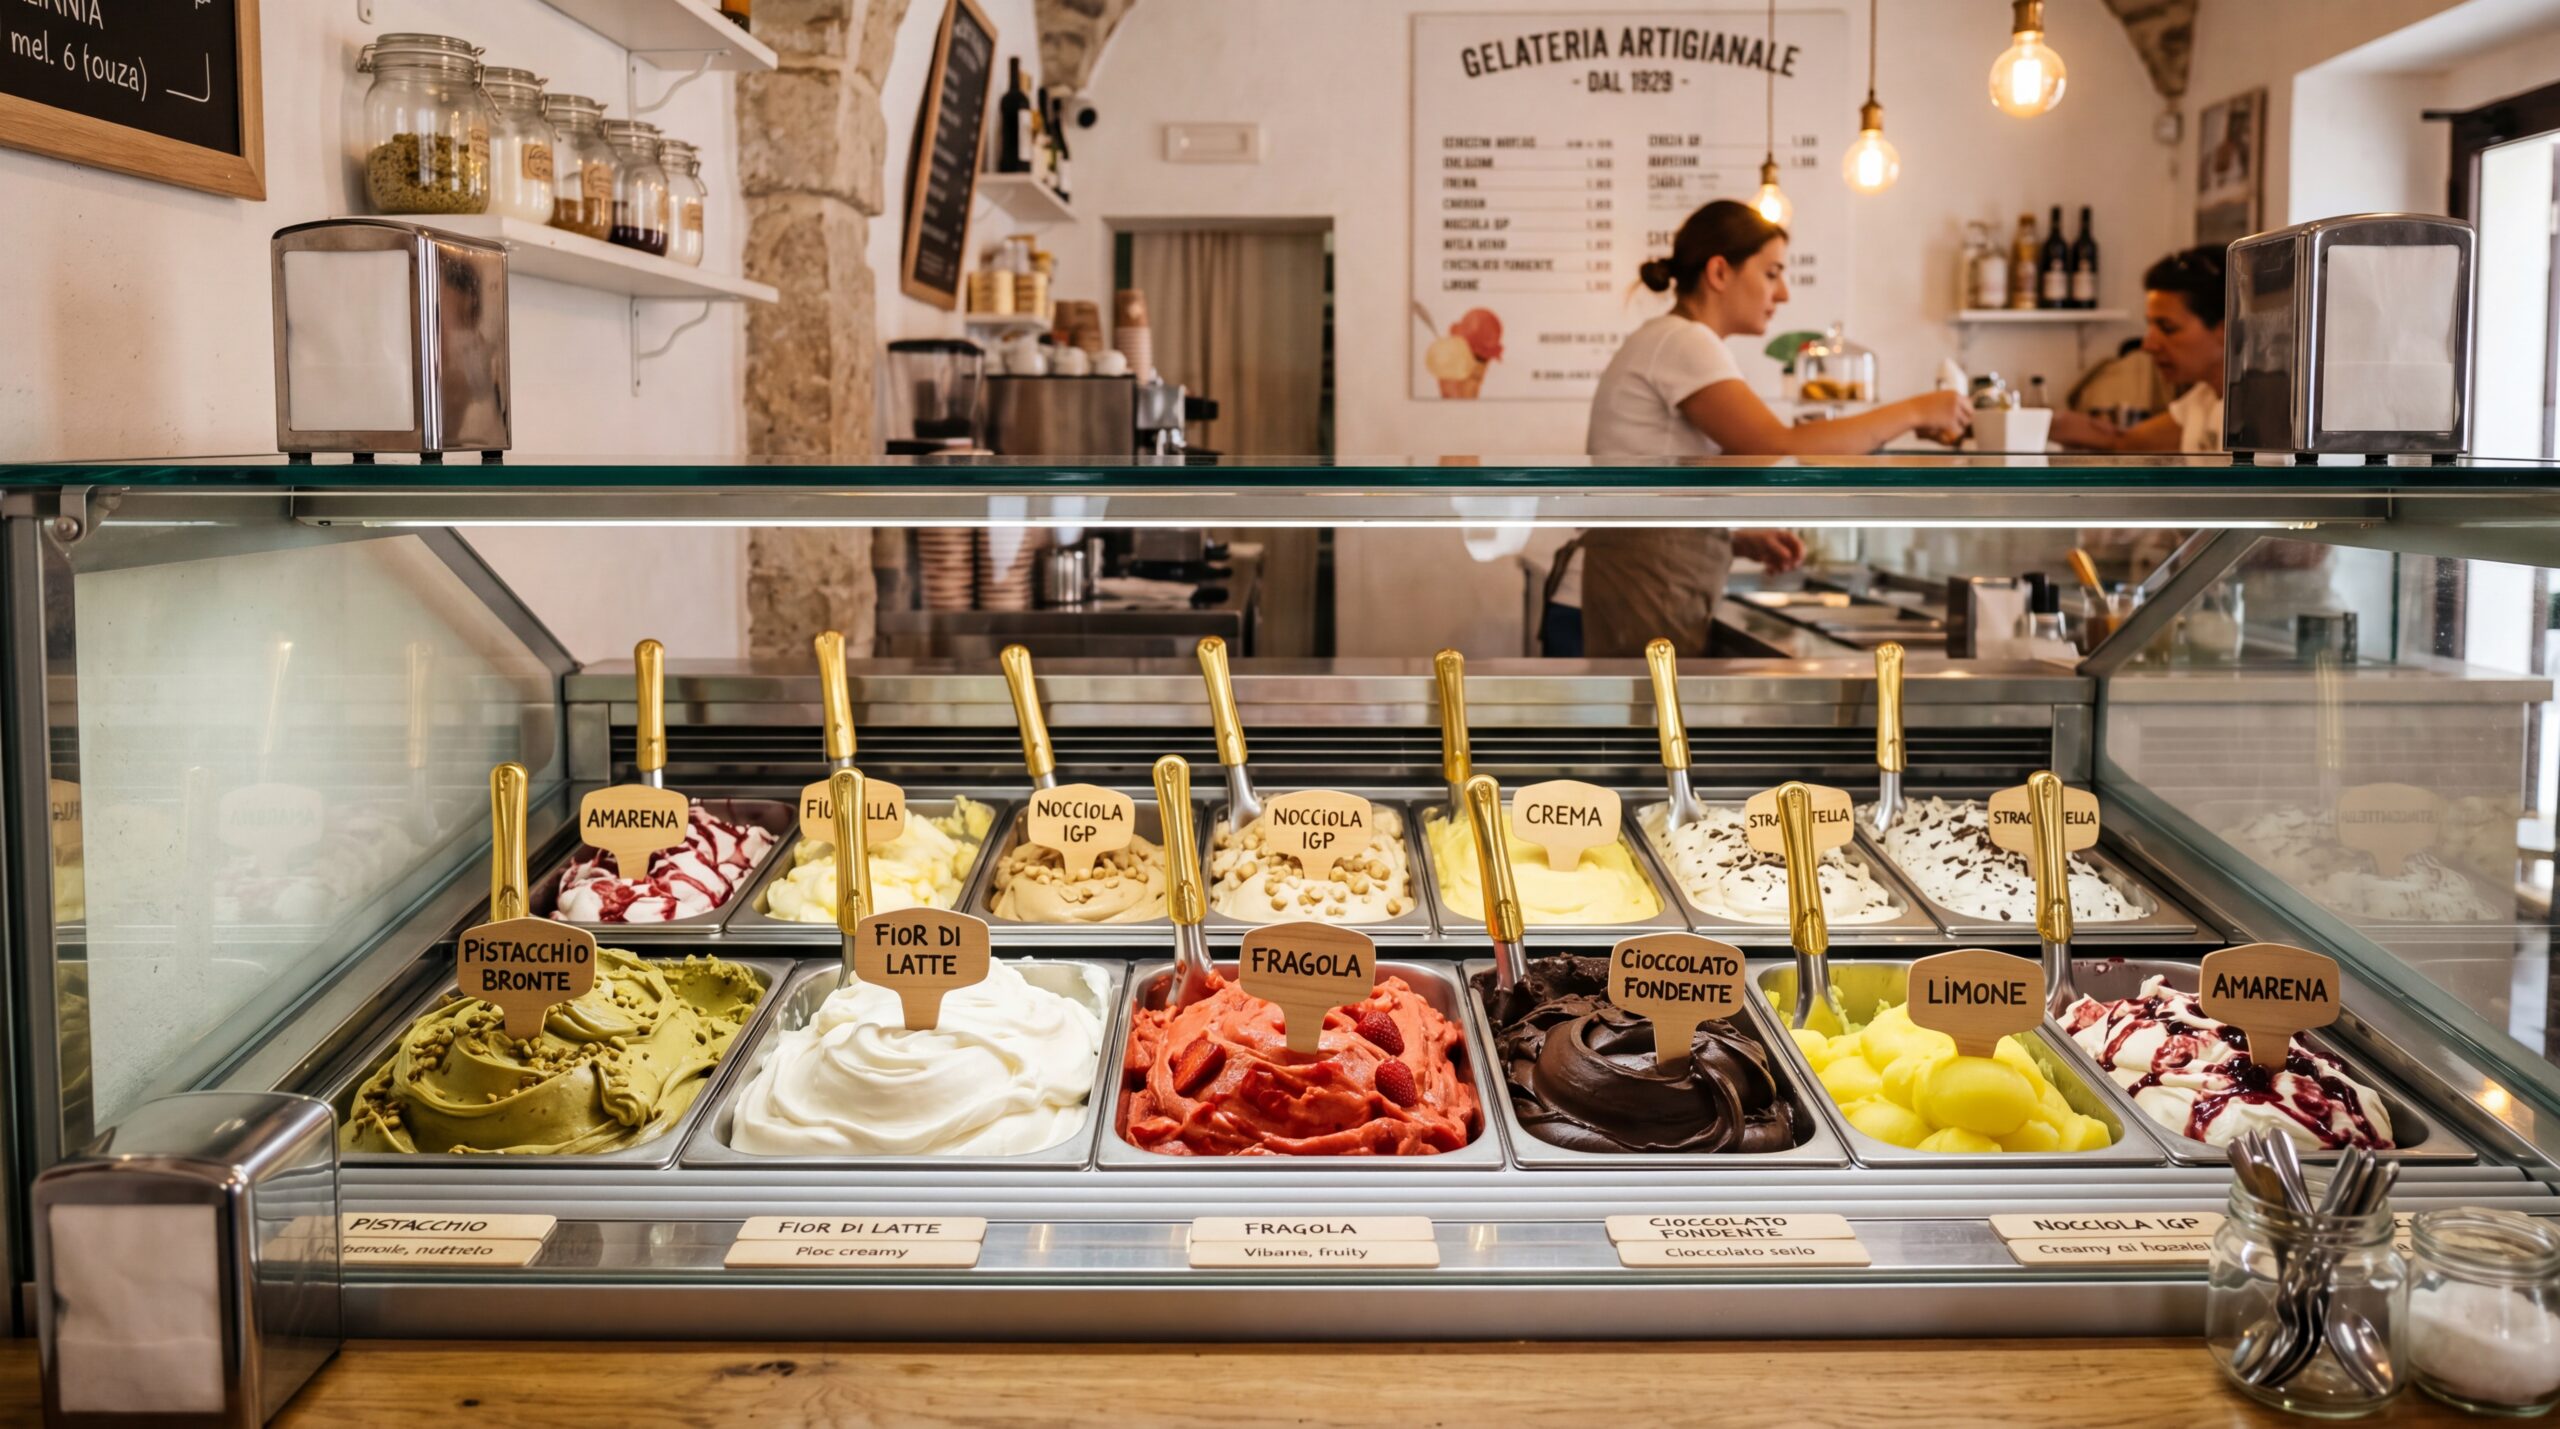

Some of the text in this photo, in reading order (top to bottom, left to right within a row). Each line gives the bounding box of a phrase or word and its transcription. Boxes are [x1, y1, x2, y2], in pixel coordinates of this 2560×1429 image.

[11, 30, 55, 65] mel.
[63, 43, 76, 71] 6
[1461, 27, 1801, 78] GELATERIA ARTIGIANALE
[1587, 70, 1673, 93] DAL 1929
[586, 808, 679, 829] AMARENA
[1037, 799, 1123, 822] NOCCIOLA
[1526, 803, 1603, 827] CREMA
[1063, 824, 1097, 843] IGP
[1302, 831, 1335, 850] IGP
[938, 925, 961, 947] DI
[886, 953, 957, 975] LATTE
[1251, 947, 1362, 978] FRAGOLA
[482, 968, 571, 992] BRONTE
[1624, 976, 1733, 1004] FONDENTE
[2212, 972, 2329, 1003] AMARENA
[349, 1217, 488, 1232] PISTACCHIO
[778, 1221, 942, 1234] FIOR DI LATTE
[1244, 1222, 1357, 1235] FRAGOLA
[1649, 1217, 1788, 1227] CIOCCOLATO
[2033, 1217, 2199, 1231] NOCCIOLA IGP
[1660, 1228, 1783, 1239] FONDENTE
[839, 1248, 909, 1259] creamy
[2038, 1244, 2111, 1256] Creamy
